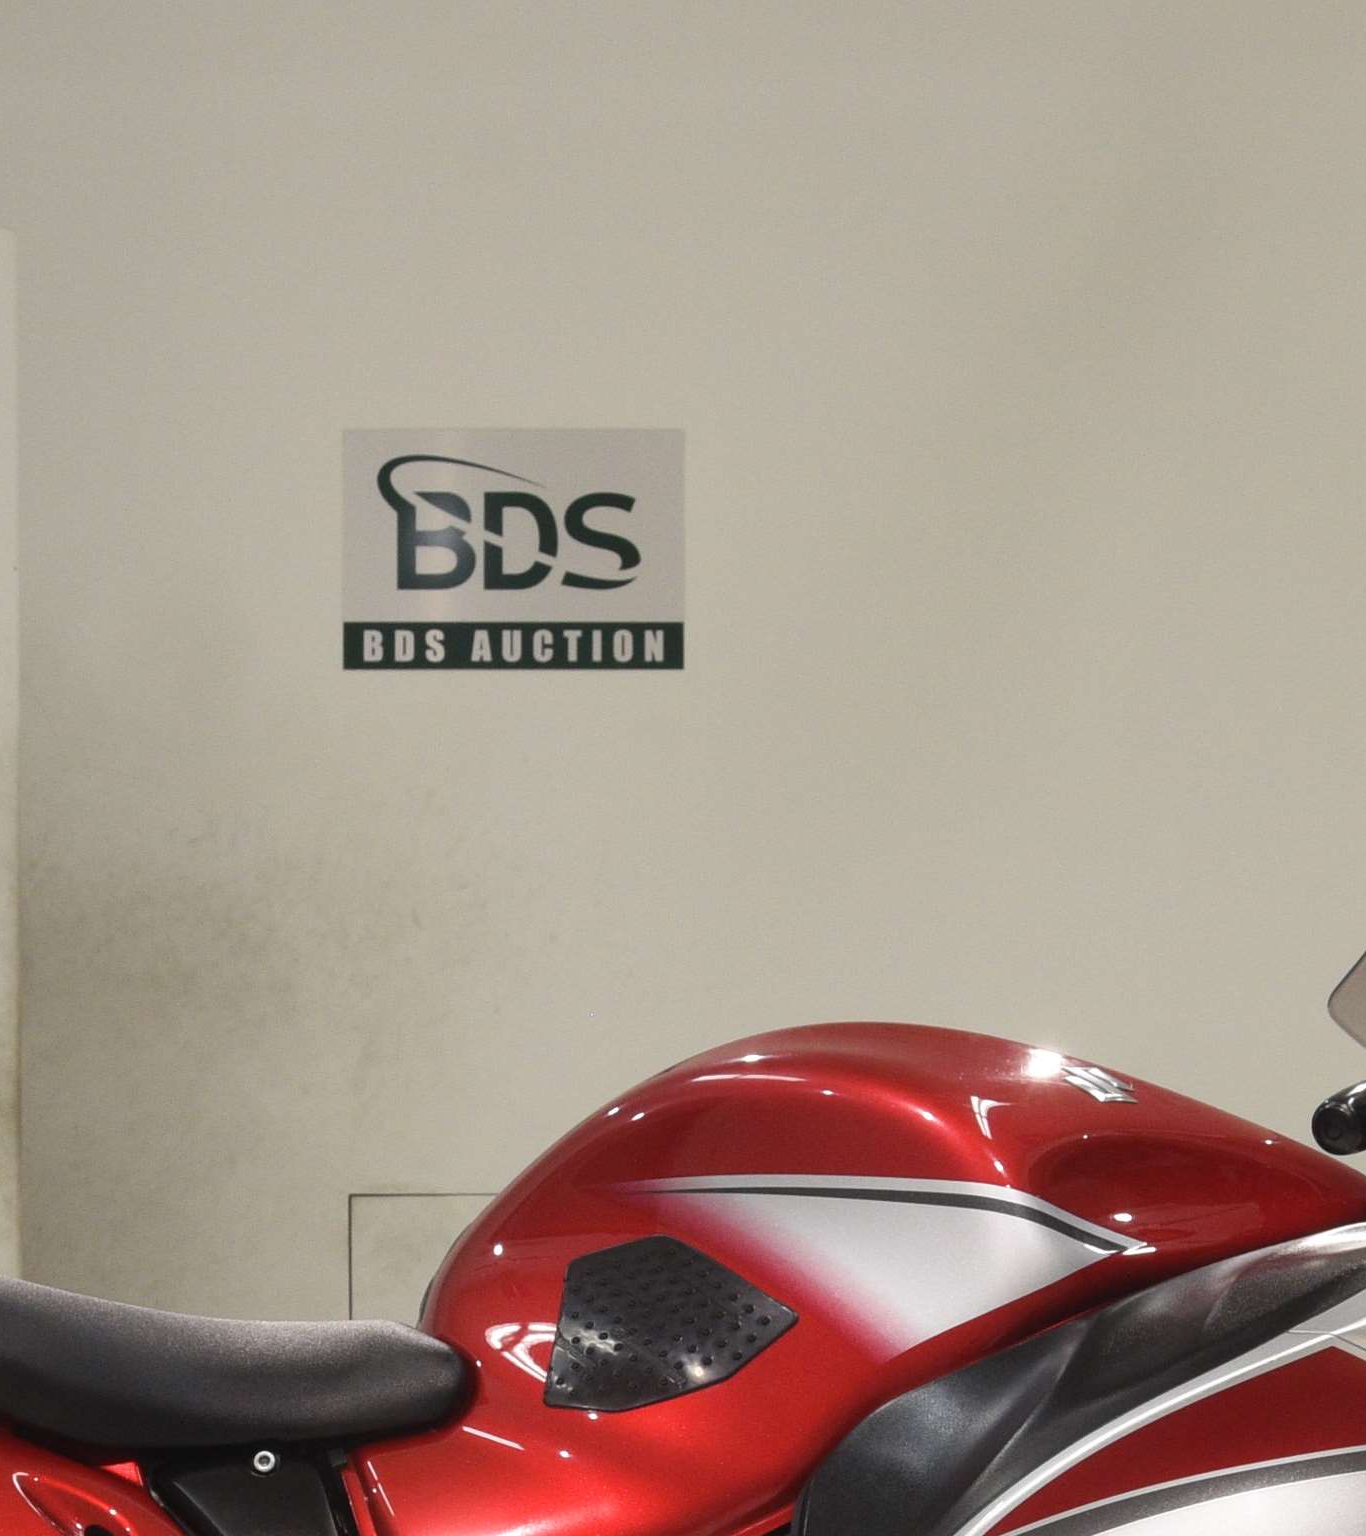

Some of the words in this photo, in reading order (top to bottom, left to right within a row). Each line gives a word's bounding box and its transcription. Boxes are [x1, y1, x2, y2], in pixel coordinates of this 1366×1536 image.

[379, 472, 642, 590] BDS
[362, 629, 447, 663] BDS
[471, 629, 665, 663] AUCTION
